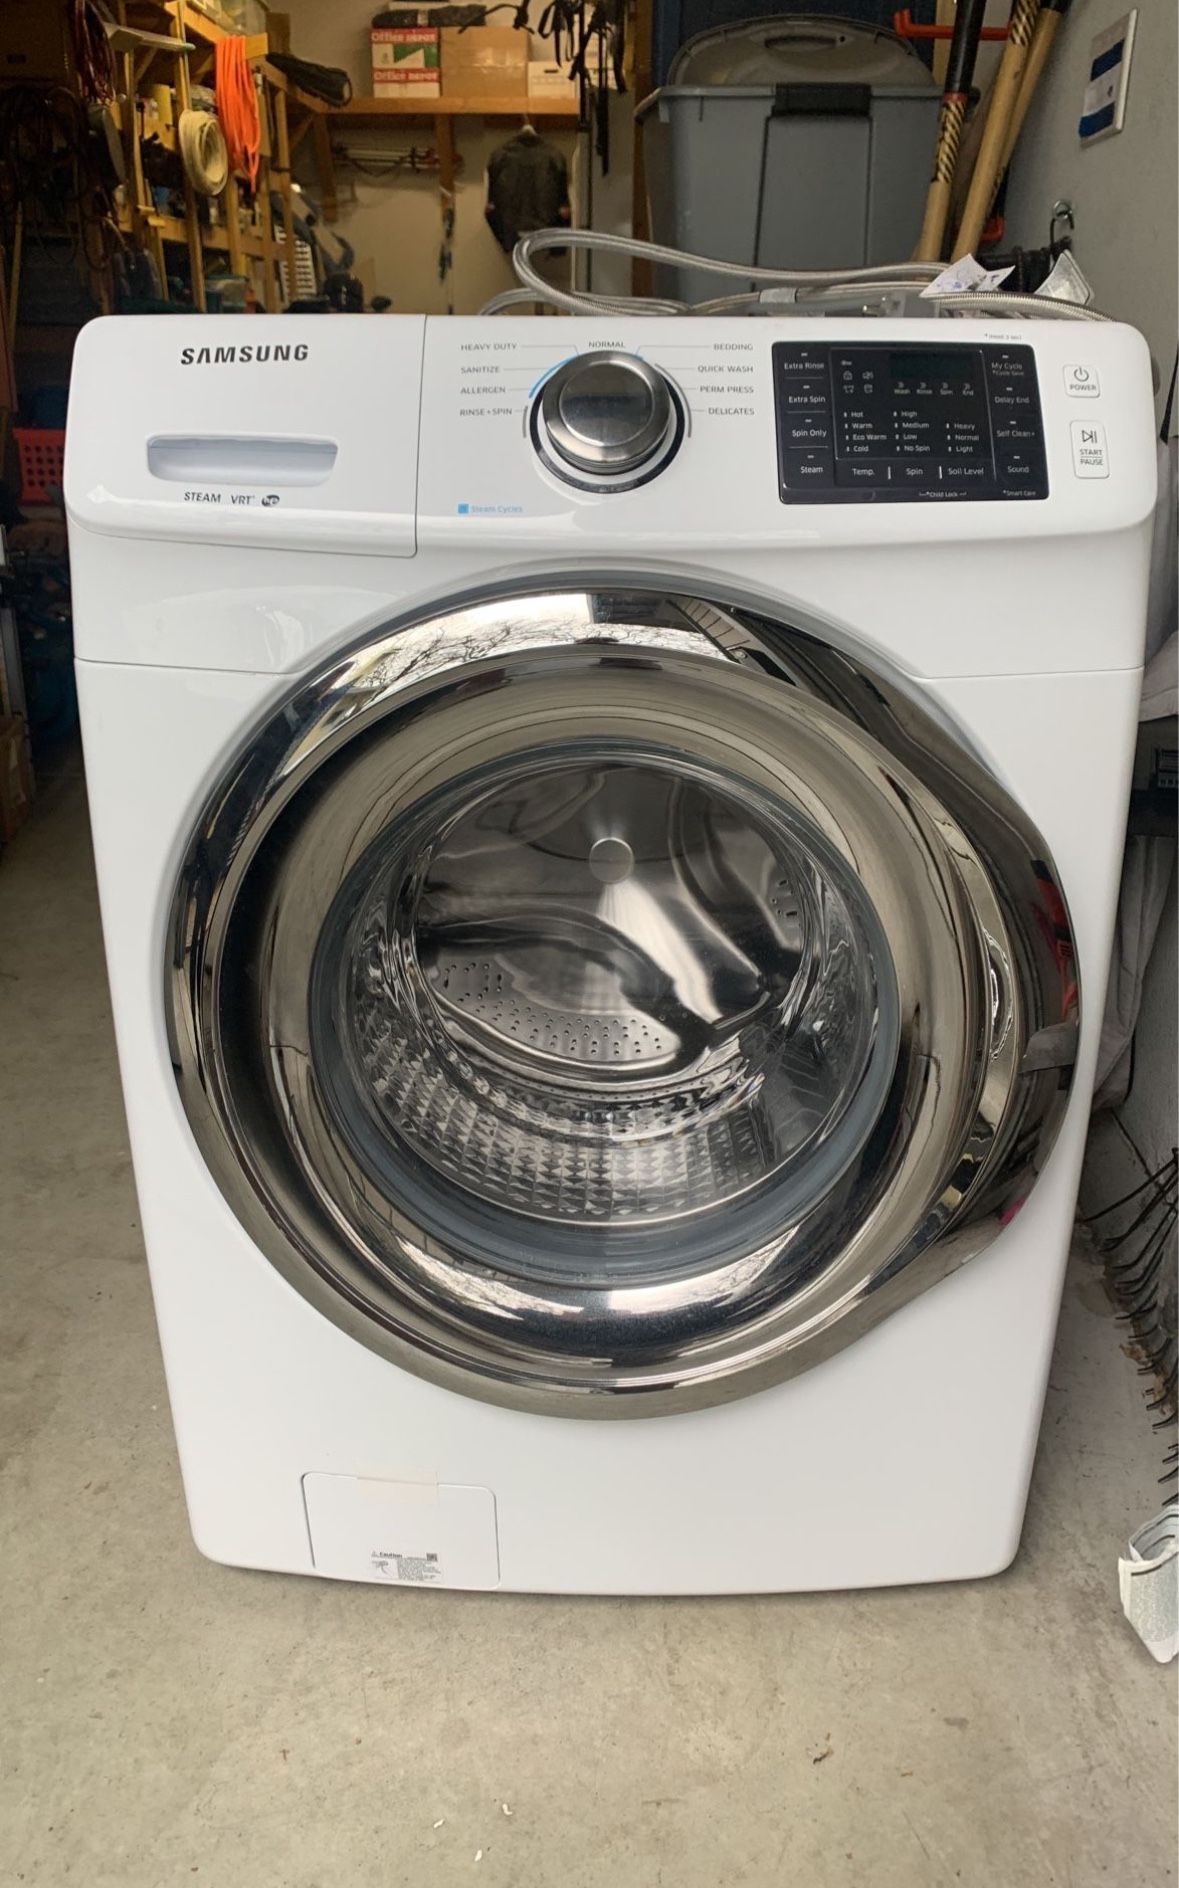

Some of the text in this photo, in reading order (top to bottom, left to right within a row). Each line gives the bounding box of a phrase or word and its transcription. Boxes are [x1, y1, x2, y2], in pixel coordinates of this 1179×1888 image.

[371, 32, 404, 42] Office
[374, 71, 407, 81] Office
[180, 344, 308, 365] SAMSUNG
[460, 366, 500, 374] SANITIZE
[698, 365, 724, 374] QUICK
[784, 362, 824, 370] Extra Rinse
[991, 362, 1022, 370] My Cycle
[460, 386, 506, 394] ALLERGEN
[727, 386, 754, 394] PRESS
[788, 395, 826, 404] Extra Spin
[994, 396, 1030, 404] Delay End
[708, 407, 755, 416] DELICATES
[901, 410, 918, 418] High
[954, 422, 975, 431] Heavy
[792, 429, 827, 438] Spin Only
[915, 445, 930, 453] Spin
[1080, 448, 1102, 456] START
[1080, 458, 1104, 466] PAUSE
[800, 466, 824, 474] Steam
[852, 468, 875, 476] Temp.
[906, 468, 923, 476] Spin
[184, 492, 221, 503] STEAM
[497, 504, 524, 514] Cycles
